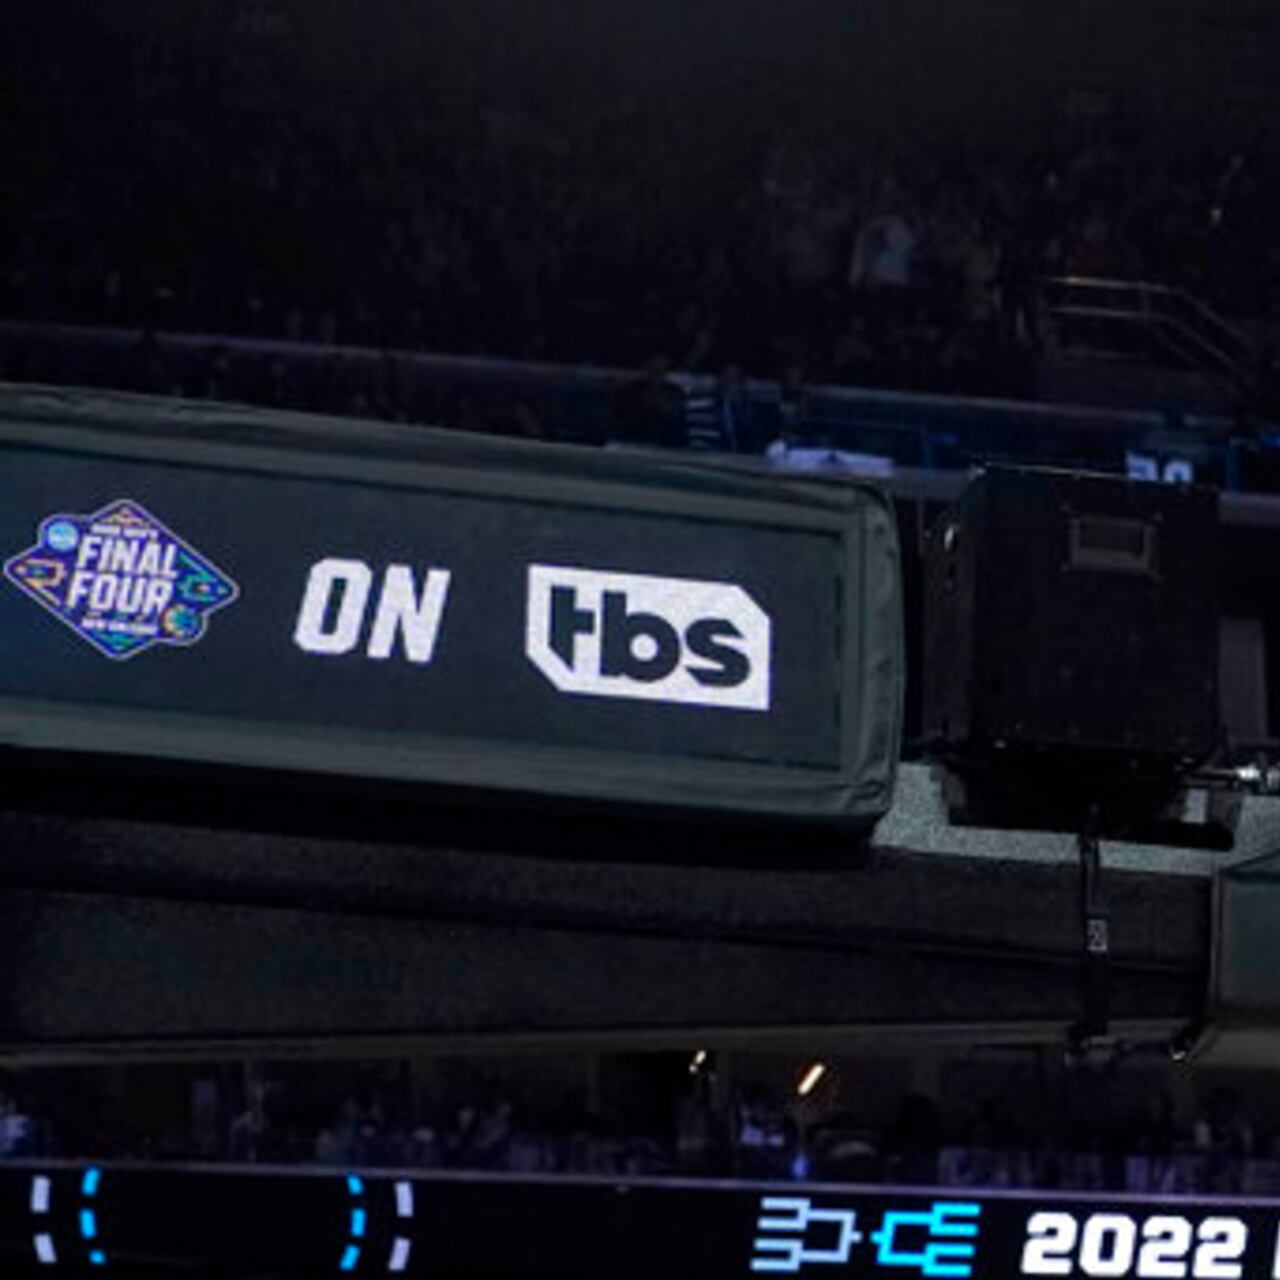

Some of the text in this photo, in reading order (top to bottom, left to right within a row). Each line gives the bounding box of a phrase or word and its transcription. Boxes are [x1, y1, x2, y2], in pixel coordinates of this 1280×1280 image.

[75, 536, 178, 579] FINAL
[67, 571, 173, 615] FOUR
[294, 558, 451, 663] ON
[548, 583, 751, 688] tbs
[1021, 1212, 1248, 1279] 2022
